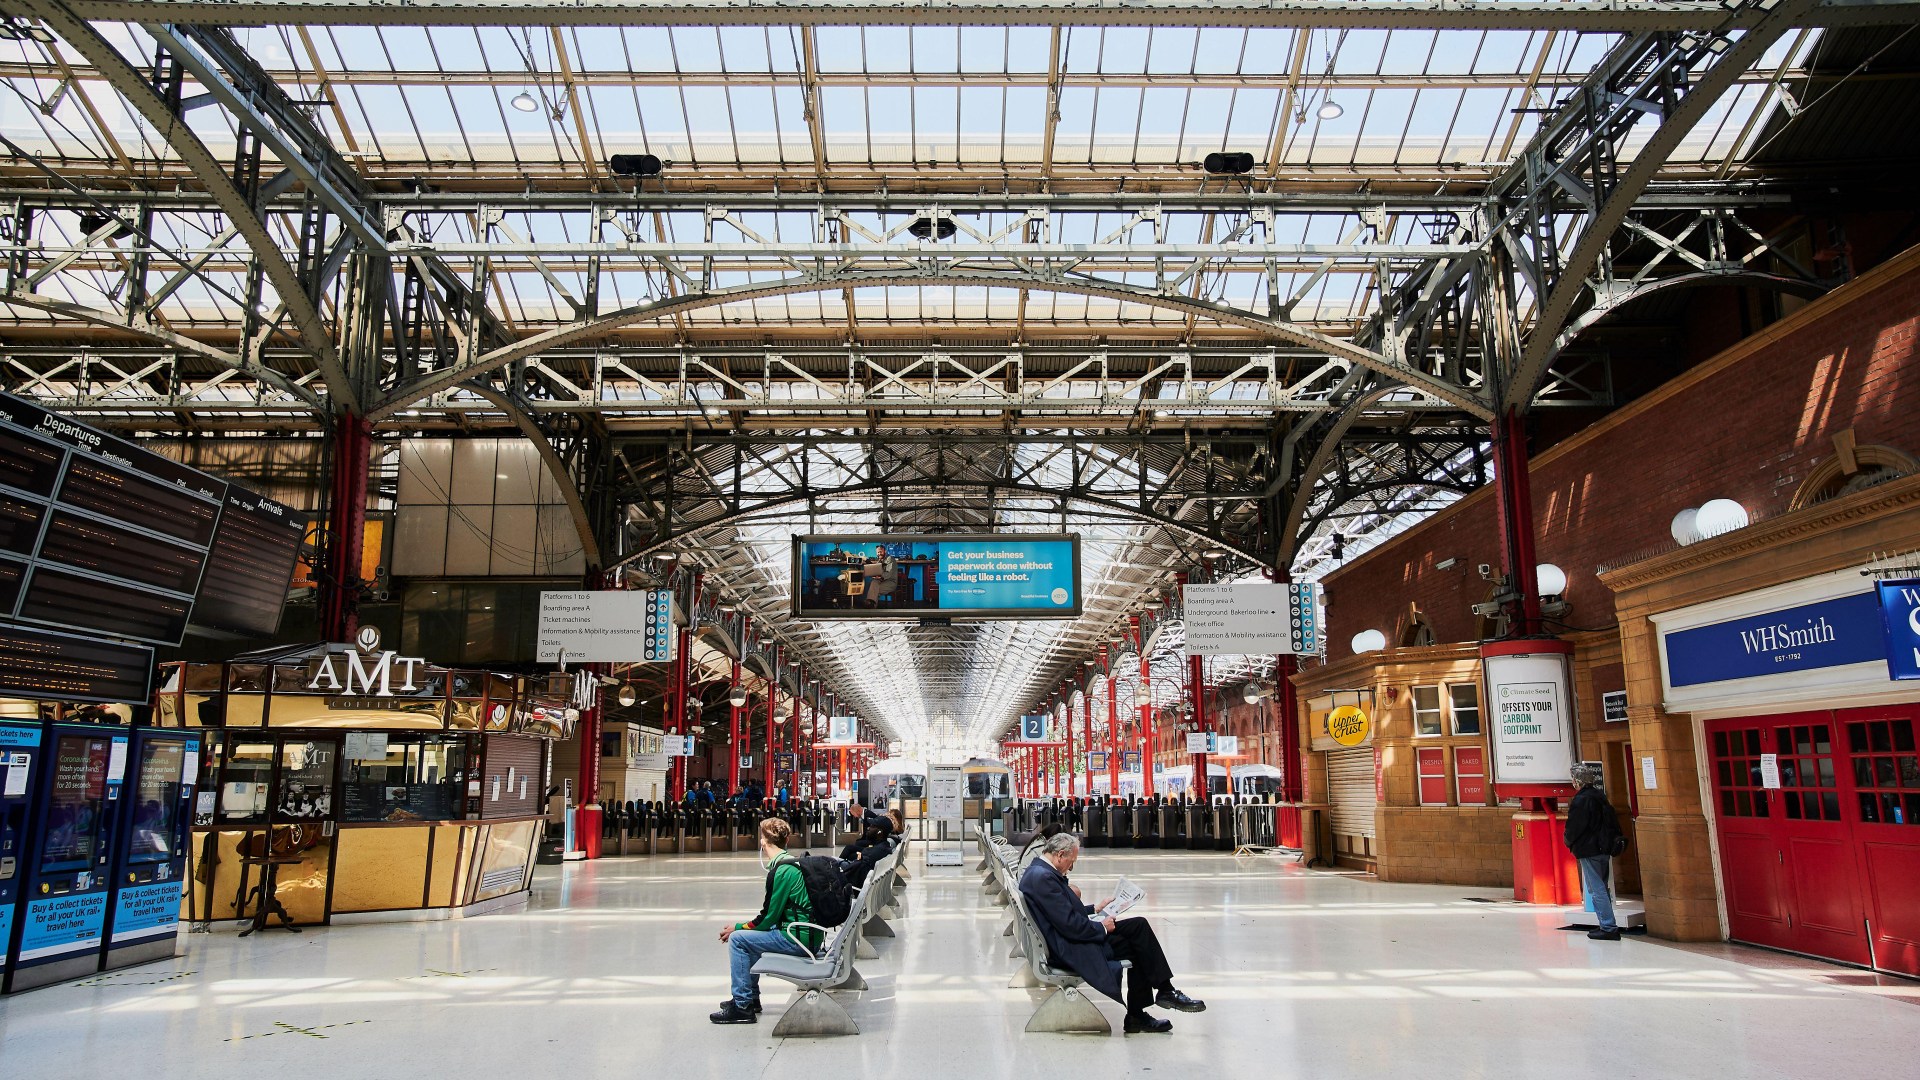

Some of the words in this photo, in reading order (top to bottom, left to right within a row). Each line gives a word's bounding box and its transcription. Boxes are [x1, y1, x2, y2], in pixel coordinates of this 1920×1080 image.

[43, 413, 101, 446] Departures
[33, 424, 55, 437] Actual
[77, 440, 92, 452] Time
[102, 450, 133, 467] Destination
[199, 487, 214, 498] Actual
[230, 496, 240, 506] Time
[241, 501, 255, 512] Origin
[257, 498, 283, 516] Arrivals
[948, 551, 964, 559] Get
[964, 553, 984, 561] your
[986, 551, 1025, 559] business
[948, 562, 995, 572] paperwork
[996, 562, 1018, 570] done
[1019, 562, 1053, 570] without
[947, 573, 977, 583] feeling
[978, 573, 995, 581] like
[1003, 573, 1030, 581] robot.
[584, 628, 609, 636] Mobility
[1740, 616, 1836, 654] WHSmith
[308, 649, 425, 697] AMT
[573, 669, 599, 711] AMT
[1501, 701, 1531, 713] OFFSETS
[1531, 701, 1553, 712] YOUR
[1502, 713, 1532, 724] CARBON
[839, 722, 848, 735] 3
[1030, 720, 1039, 734] 2
[1503, 724, 1542, 735] FOOTPRINT
[19, 730, 34, 739] here
[60, 755, 91, 763] Coronavirus
[288, 749, 331, 765] AMT
[85, 765, 100, 773] hands
[121, 891, 133, 900] Buy
[134, 890, 140, 898] &
[140, 888, 161, 897] collect
[161, 885, 180, 895] tickets
[32, 904, 47, 914] Buy
[55, 900, 79, 910] collect
[80, 897, 103, 906] tickets
[124, 901, 133, 909] for
[134, 899, 142, 907] all
[142, 898, 156, 908] your
[156, 896, 165, 904] UK
[166, 895, 175, 903] rail
[35, 915, 46, 924] for
[48, 912, 57, 921] all
[57, 911, 74, 921] your
[75, 909, 85, 917] UK
[86, 906, 97, 916] rail
[133, 907, 151, 917] travel
[151, 906, 165, 914] here
[46, 921, 67, 932] travel
[68, 920, 85, 928] here
